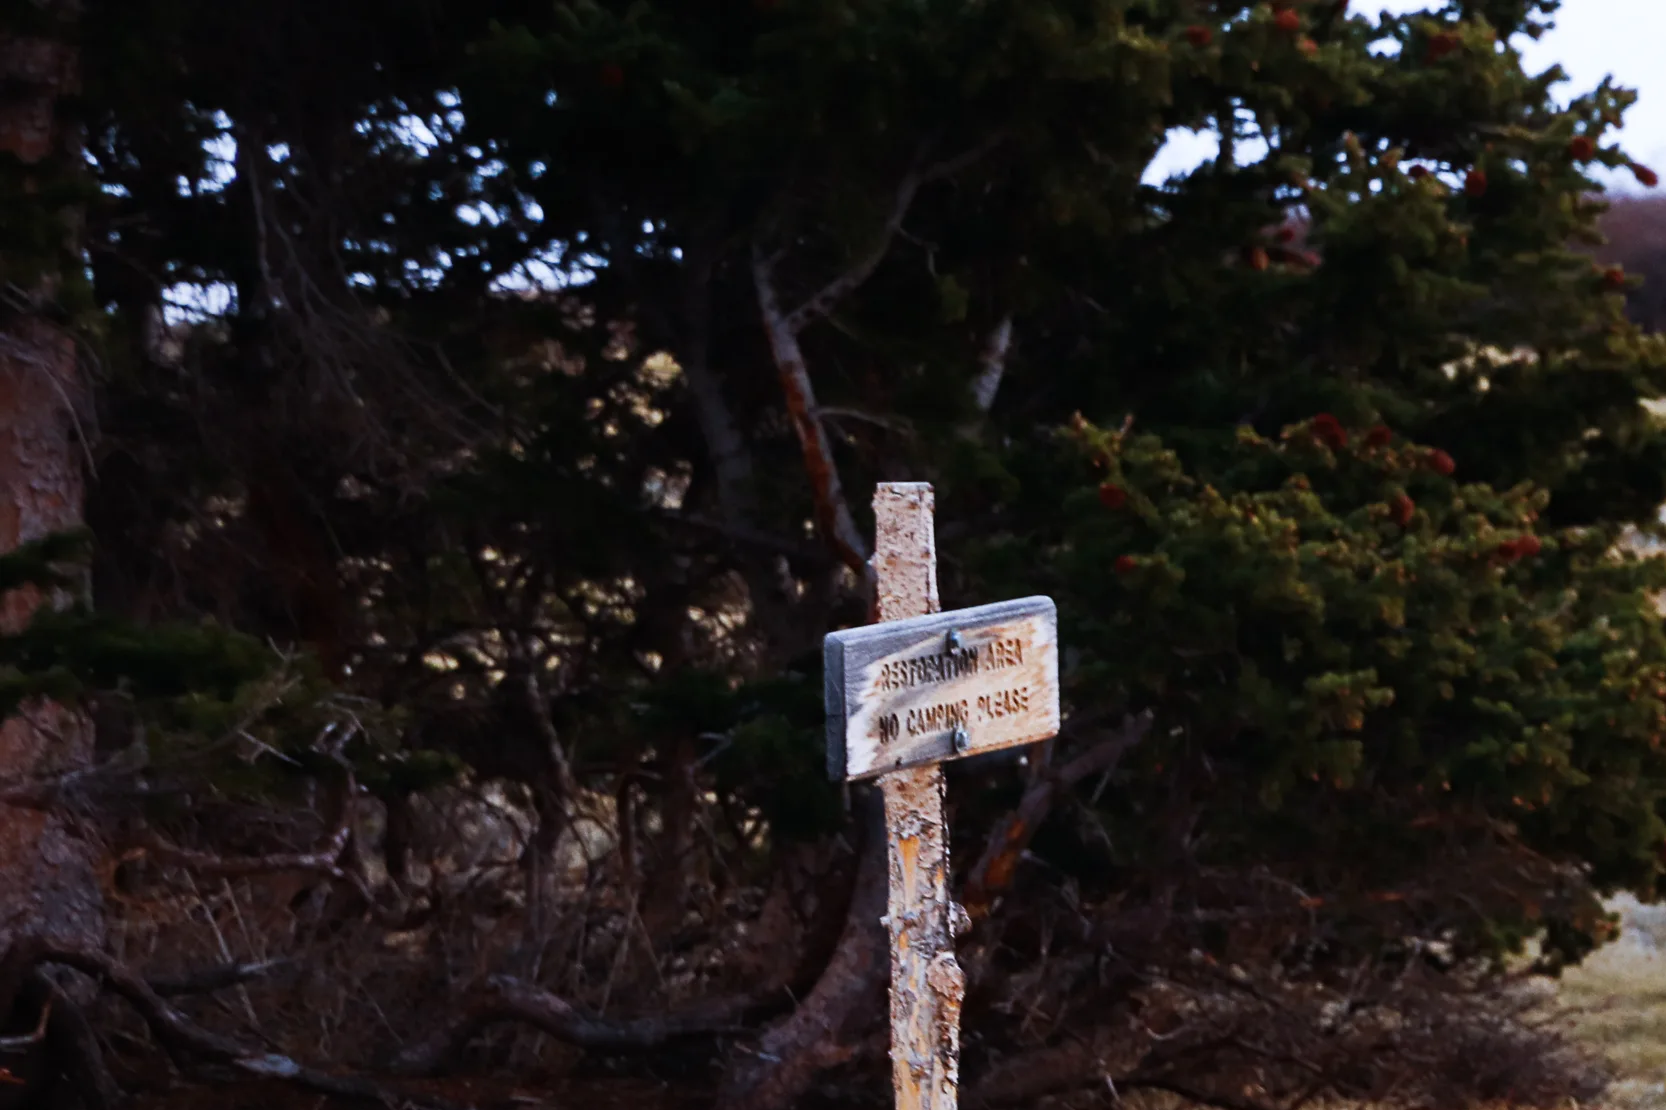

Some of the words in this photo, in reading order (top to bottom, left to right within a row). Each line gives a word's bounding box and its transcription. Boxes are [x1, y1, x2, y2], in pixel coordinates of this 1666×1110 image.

[881, 646, 979, 691] RESTORATION
[985, 638, 1024, 671] AREA
[879, 714, 900, 744] NO
[906, 699, 970, 735] CAMPING
[977, 686, 1029, 721] PLEASE
